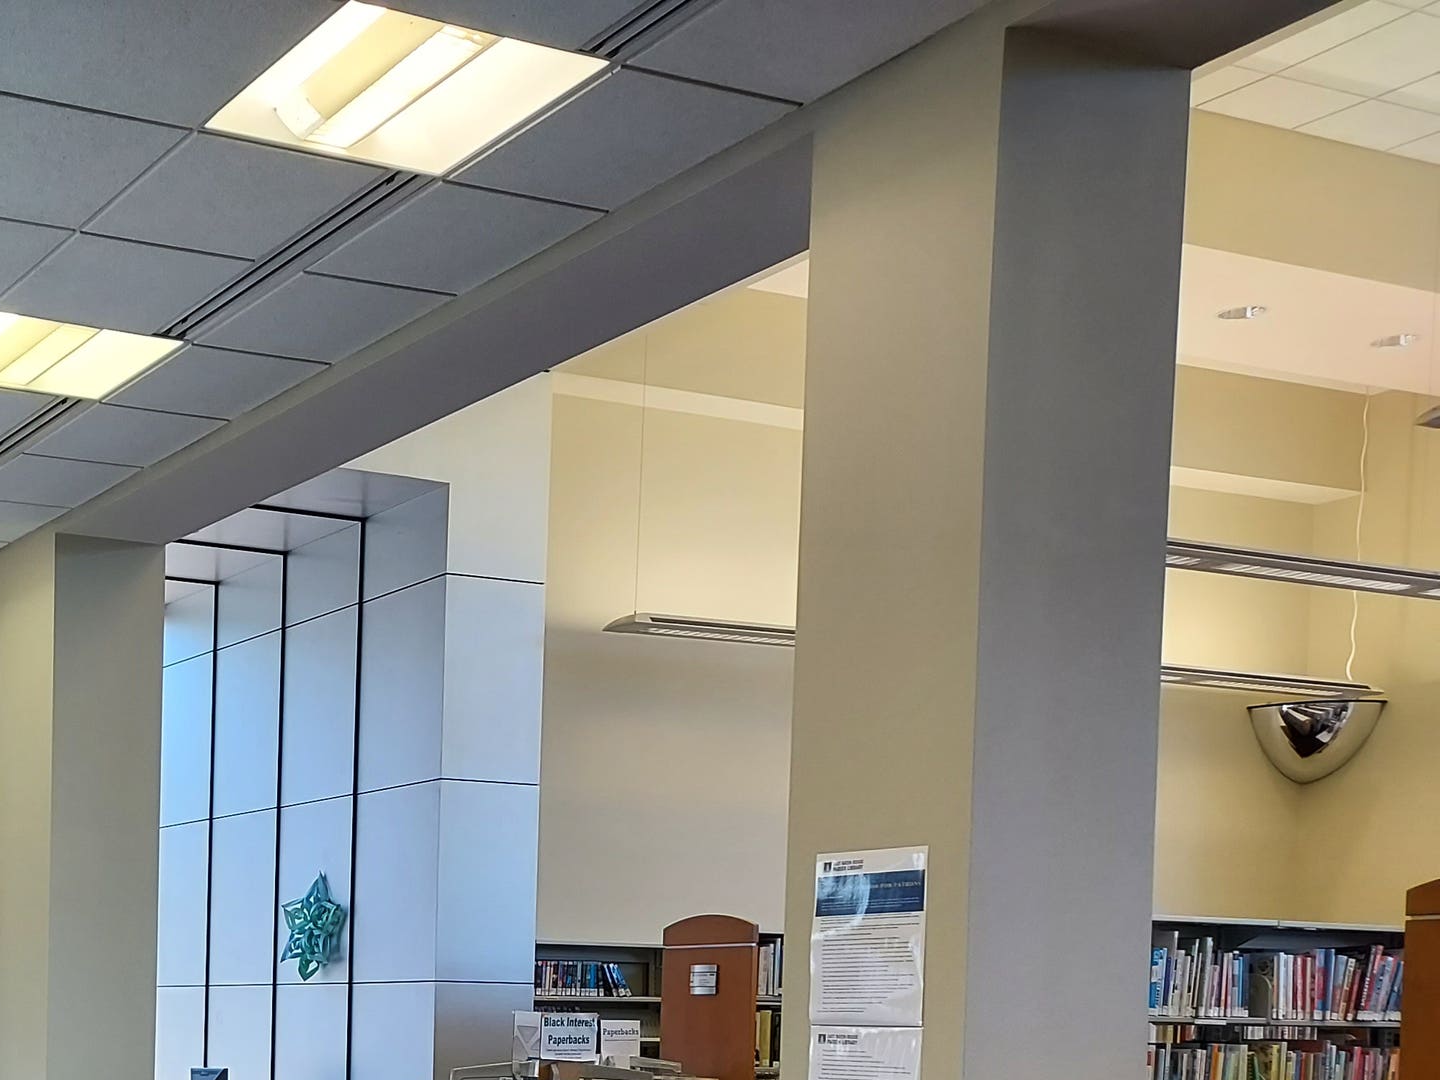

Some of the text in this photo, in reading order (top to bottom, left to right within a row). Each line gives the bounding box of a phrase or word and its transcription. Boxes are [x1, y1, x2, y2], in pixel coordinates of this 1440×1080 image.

[544, 1017, 595, 1027] Black Interest
[602, 1028, 639, 1037] Paperbacks
[548, 1034, 590, 1047] Paperbacks
